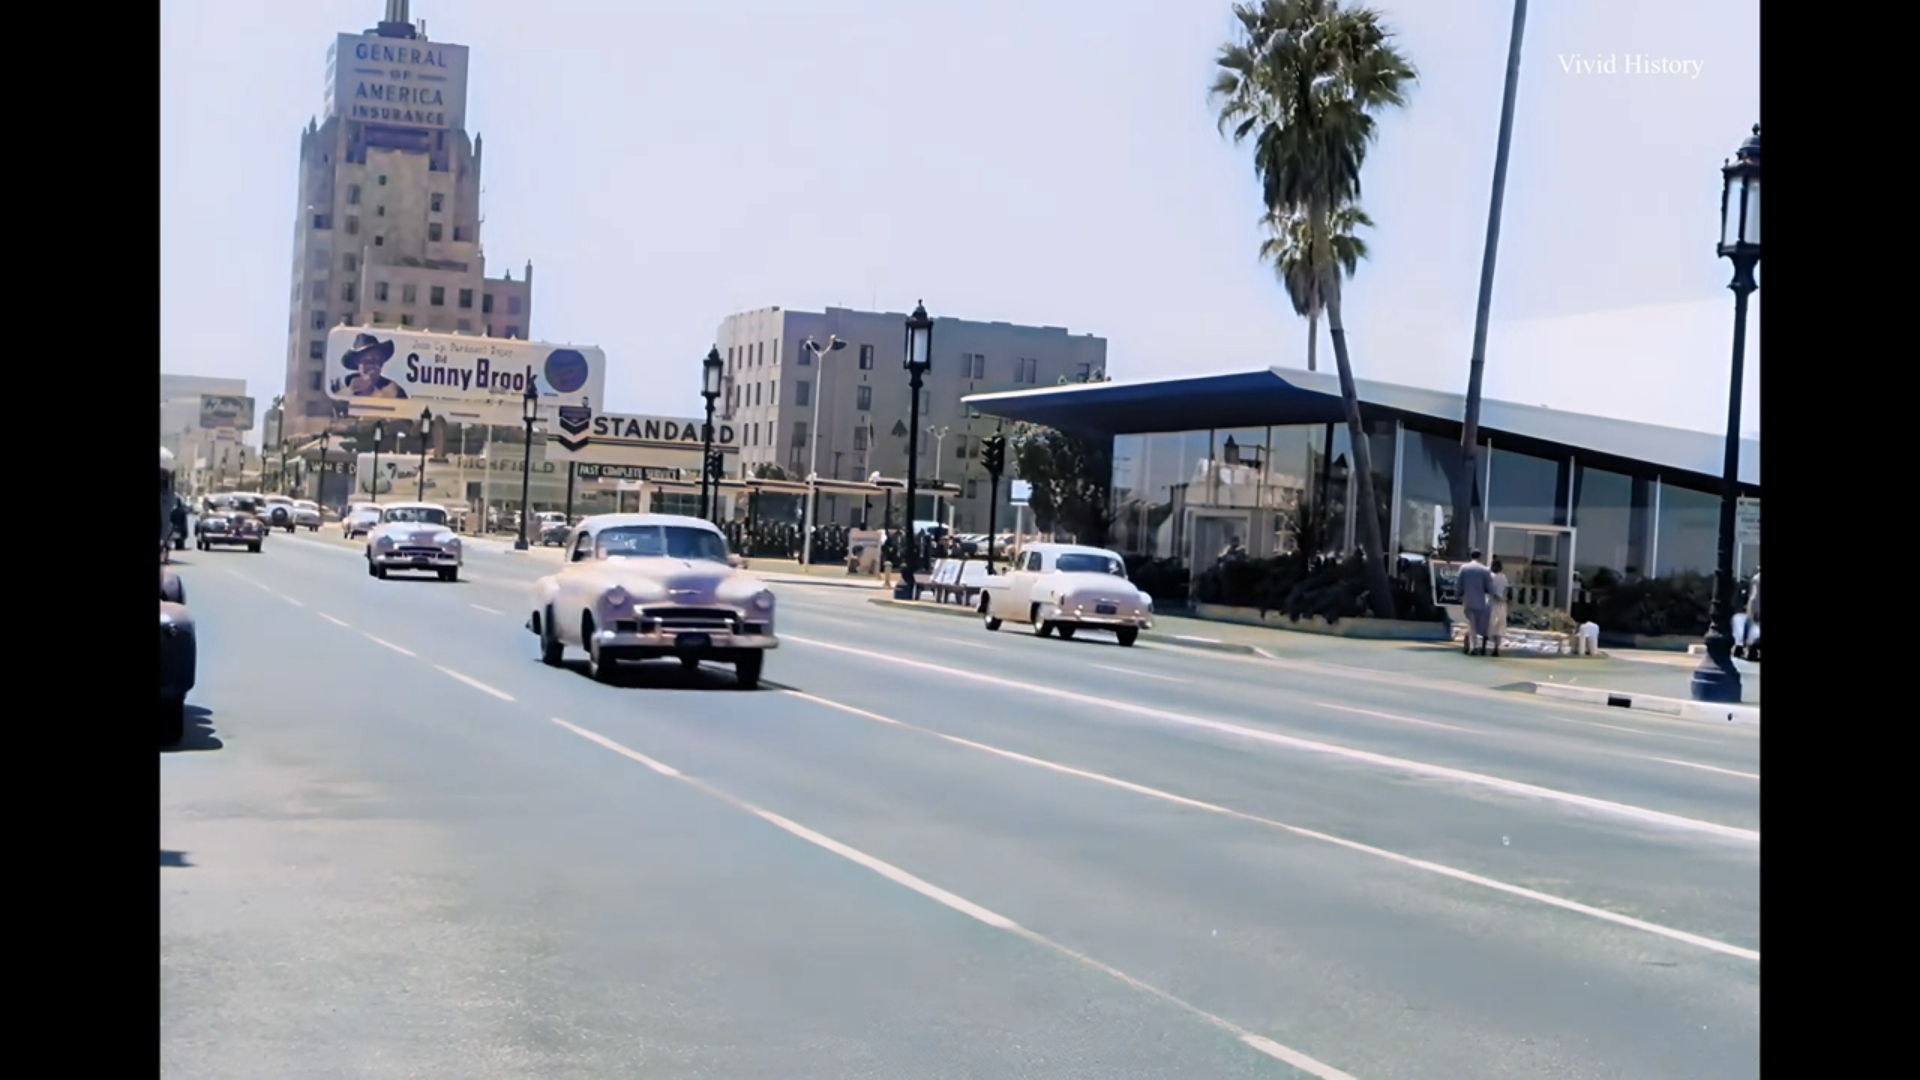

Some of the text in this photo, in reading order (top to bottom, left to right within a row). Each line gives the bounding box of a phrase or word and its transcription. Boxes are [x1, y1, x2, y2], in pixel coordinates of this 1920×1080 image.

[355, 43, 447, 68] GENERAL
[390, 70, 411, 80] OF
[355, 81, 443, 106] AMERICA
[352, 105, 444, 125] INSURANCE
[406, 352, 472, 391] Sunny
[476, 358, 538, 392] Brook
[593, 416, 734, 444] STANDARD
[579, 464, 599, 476] FAST
